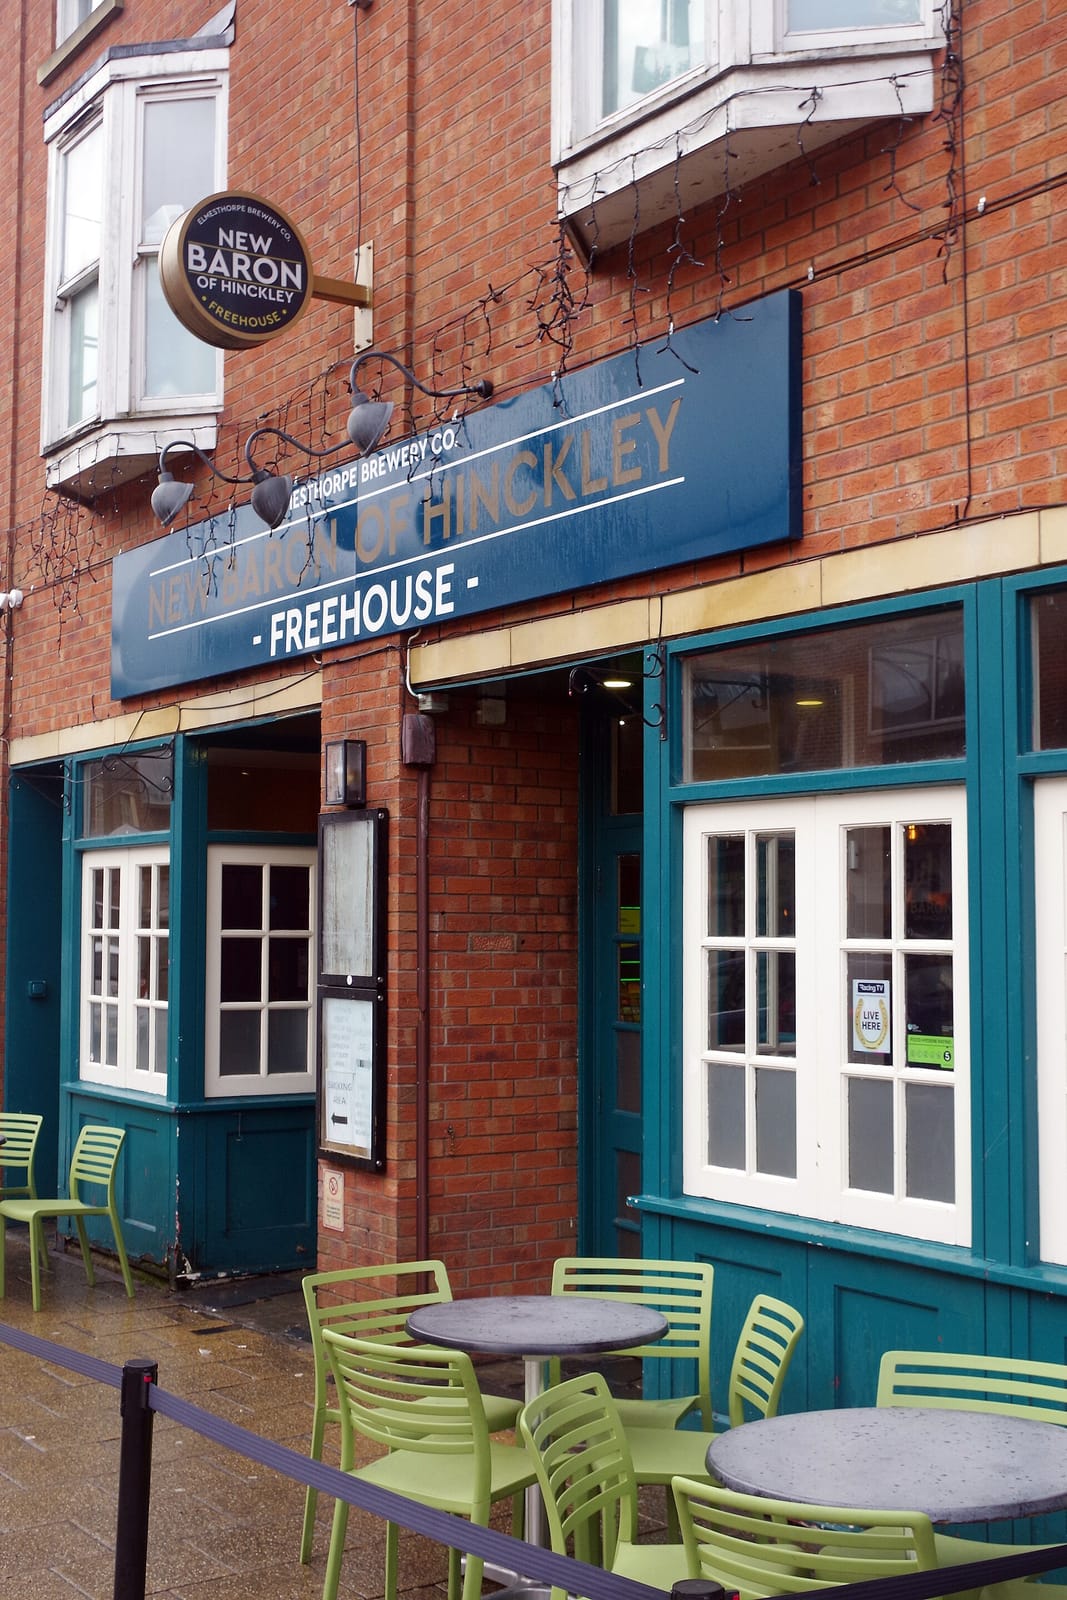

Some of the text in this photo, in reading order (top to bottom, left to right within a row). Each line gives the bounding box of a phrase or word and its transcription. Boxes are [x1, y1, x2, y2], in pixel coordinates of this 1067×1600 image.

[197, 204, 292, 242] ELMESTHORPE BREWERY CO.
[218, 227, 273, 255] NEW
[188, 243, 303, 290] BARON
[196, 275, 295, 304] OF HINCKLEY
[208, 301, 281, 328] FREEHOUSE
[289, 466, 358, 510] ESTHORPE
[361, 438, 428, 483] BREWERY
[149, 396, 683, 629] NEW BARON OF HINCKLEY
[270, 563, 455, 657] FREEHOUSE
[859, 983, 884, 993] Racing TV
[861, 1021, 881, 1031] HERE
[863, 1011, 880, 1020] LIVE
